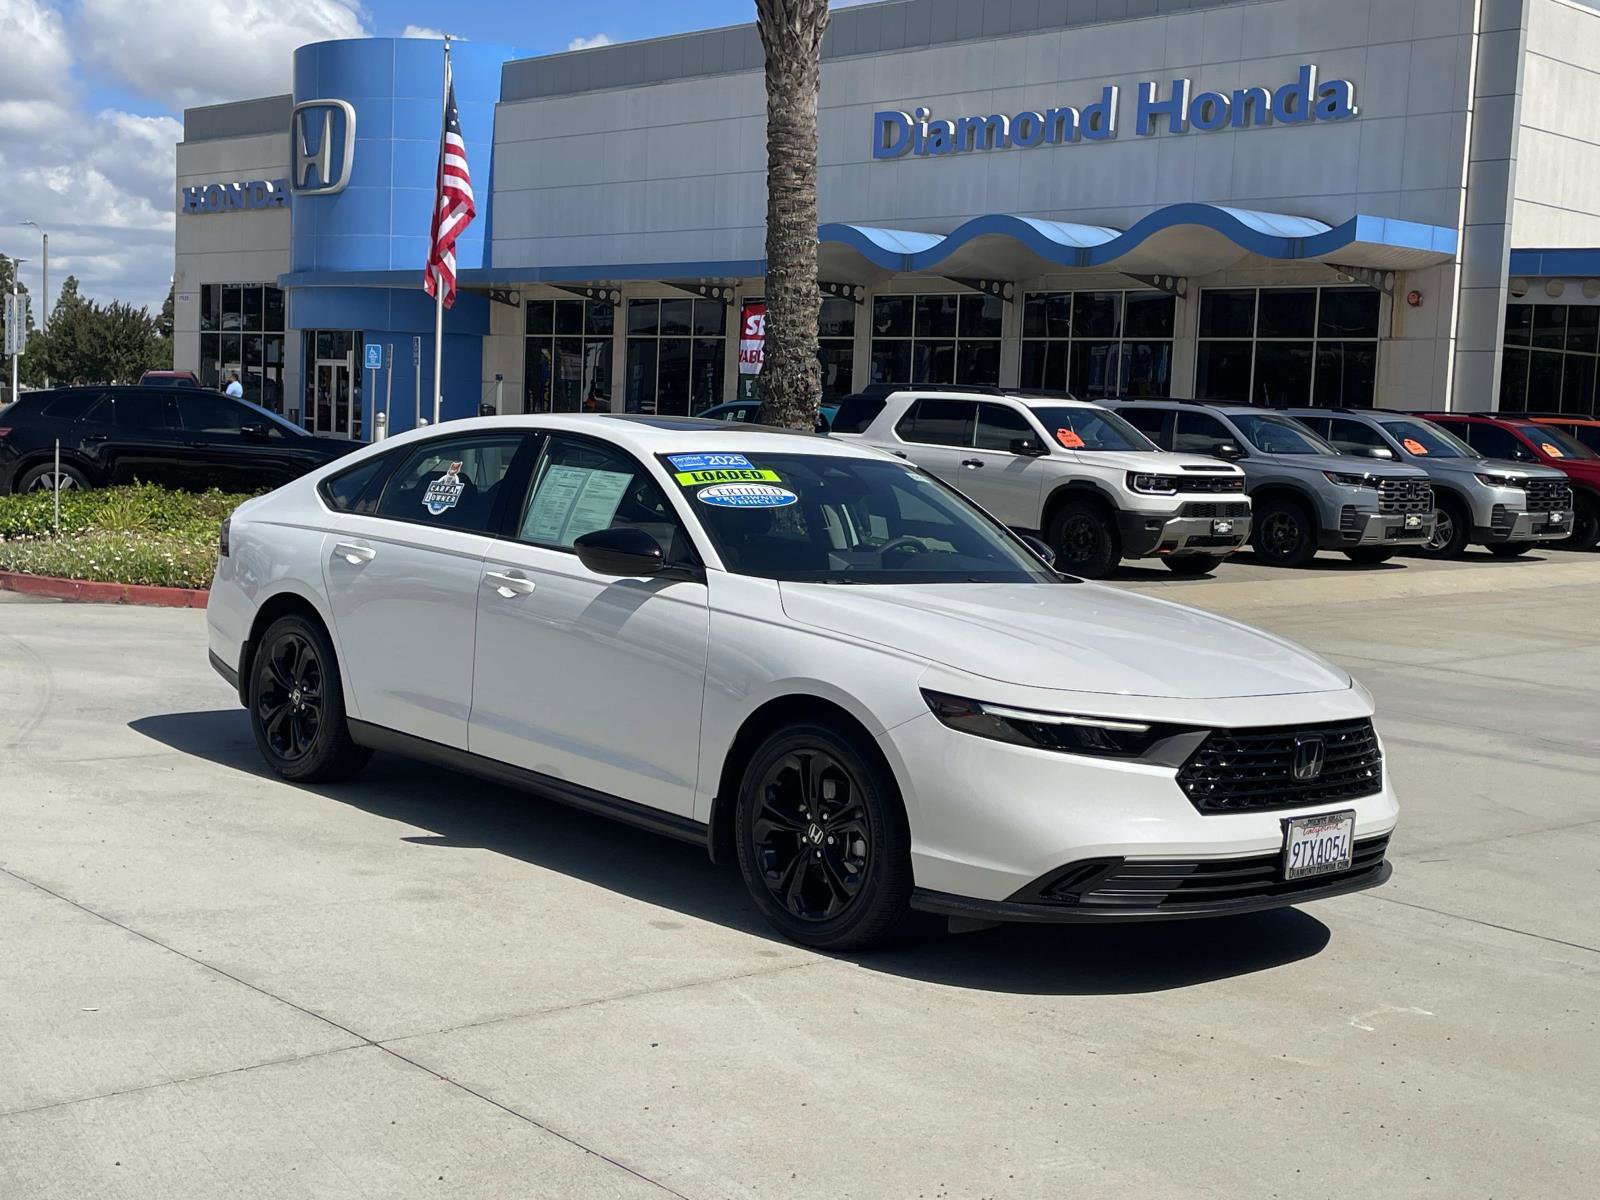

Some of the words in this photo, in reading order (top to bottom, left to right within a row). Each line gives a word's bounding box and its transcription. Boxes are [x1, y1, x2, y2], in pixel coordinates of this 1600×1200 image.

[873, 86, 1118, 159] Diamond
[1136, 64, 1358, 136] Honda
[182, 178, 292, 214] HONDA
[704, 455, 747, 466] 2025
[691, 470, 765, 482] LOADED
[430, 484, 462, 494] CARFAX
[706, 487, 783, 497] CERTIFIED
[431, 494, 456, 503] OWNER
[1291, 834, 1347, 869] 9TXA054
